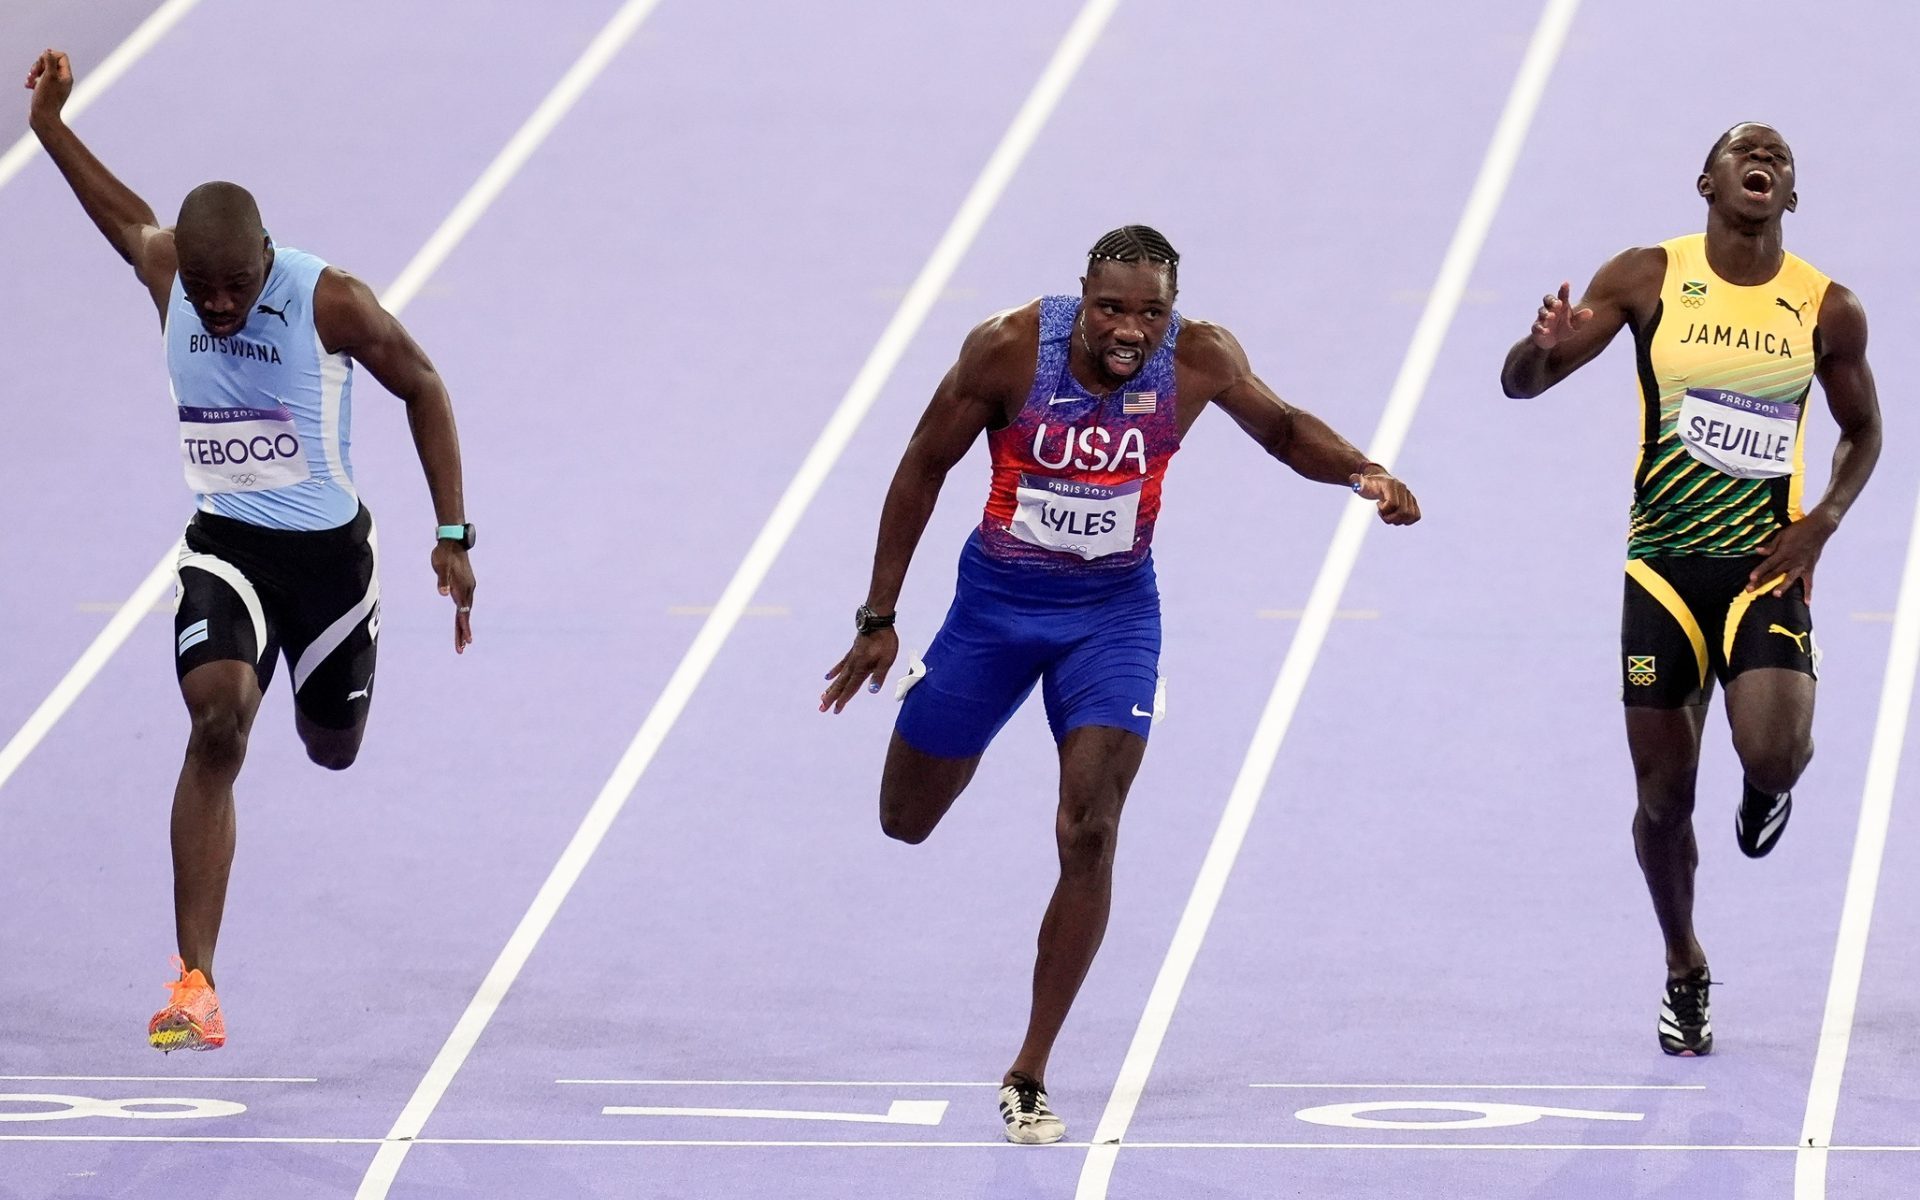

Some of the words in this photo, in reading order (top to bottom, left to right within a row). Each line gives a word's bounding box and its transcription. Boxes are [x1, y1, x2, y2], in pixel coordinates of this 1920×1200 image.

[190, 334, 282, 365] BOTSWANA
[1680, 323, 1792, 359] JAMAICA
[202, 410, 231, 420] PARIS
[1719, 392, 1753, 408] PARIS
[184, 433, 299, 465] TEBOGO
[1032, 423, 1147, 475] USA
[1687, 415, 1789, 462] SEVILLE
[1048, 481, 1081, 494] PARIS
[1084, 487, 1114, 497] 2024
[1040, 502, 1117, 536] LYLES
